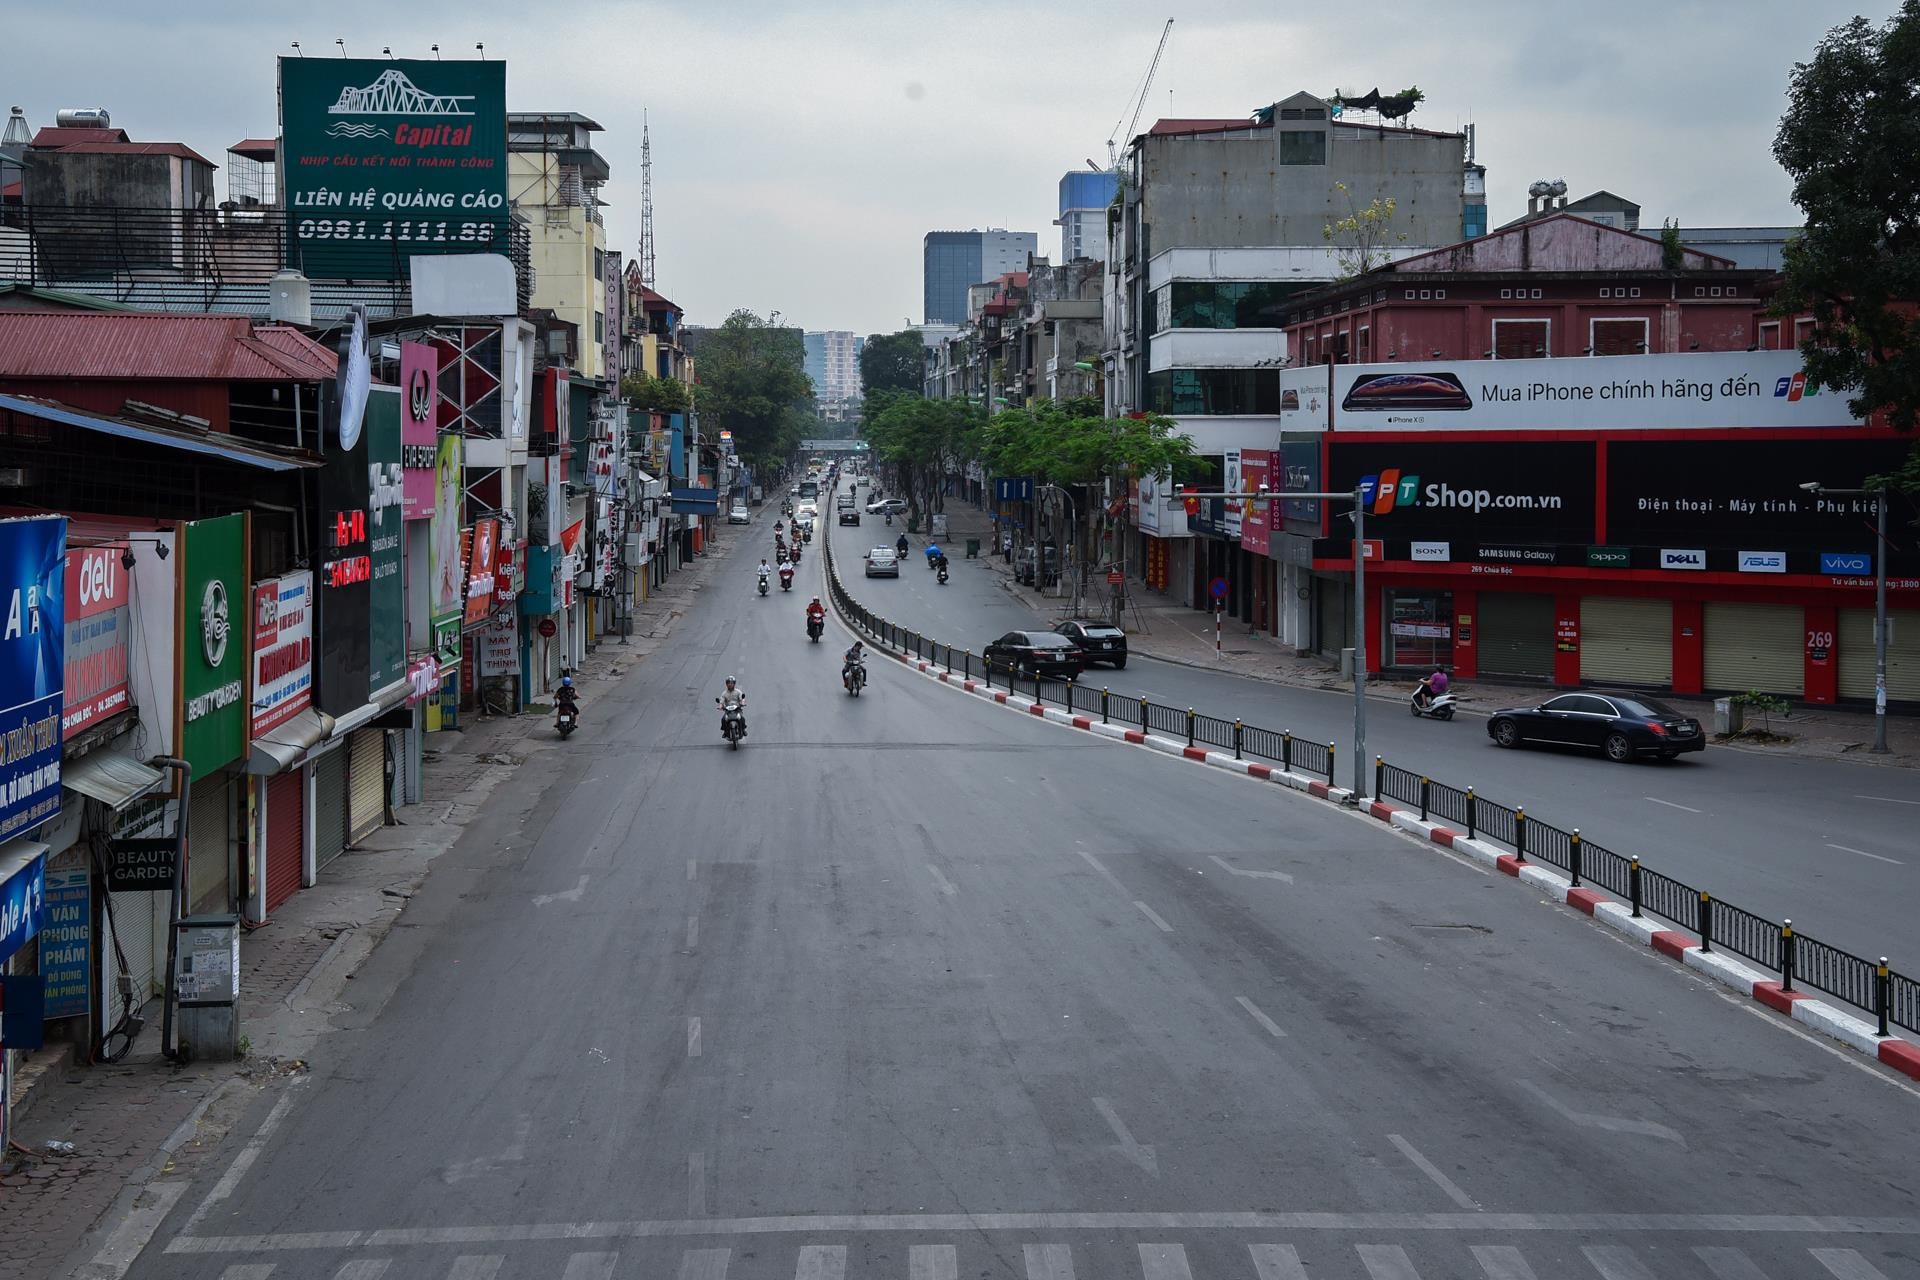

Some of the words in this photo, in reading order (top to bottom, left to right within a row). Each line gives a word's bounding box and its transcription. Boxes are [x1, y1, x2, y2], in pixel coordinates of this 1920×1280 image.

[394, 123, 472, 148] Capital
[300, 156, 330, 169] NHỊP
[334, 154, 358, 167] CẦU
[362, 154, 385, 167] KẾT
[389, 153, 411, 167] NỐI
[416, 155, 457, 168] THÀNH
[460, 155, 495, 168] CÔNG
[294, 186, 342, 206] LIÊN
[348, 187, 377, 210] HỆ
[382, 188, 454, 210] QUẢNG
[461, 188, 503, 208] CÁO
[299, 219, 495, 241] 0981.1111.88
[1481, 384, 1521, 402] Mua
[1527, 382, 1593, 401] iPhone
[1599, 380, 1654, 399] chính
[1661, 378, 1713, 402] hãng
[1719, 372, 1760, 397] đến
[1393, 416, 1413, 424] iPhone
[1425, 482, 1562, 514] Shop.com.vn
[1638, 497, 1669, 514] Điện
[1675, 498, 1713, 514] thoại
[1729, 498, 1756, 514] Máy
[1763, 498, 1797, 513] tính
[1816, 500, 1845, 517] Phụ
[500, 538, 516, 555] Phụ
[1479, 548, 1521, 559] SAMSUNG
[1523, 550, 1556, 561] Galaxy
[1590, 552, 1626, 562] oppo
[1666, 554, 1699, 565] DELL
[1742, 556, 1780, 567] ASUS
[1825, 556, 1864, 570] vivo
[80, 548, 115, 606] deli
[499, 563, 516, 579] kiện
[1471, 565, 1482, 573] 269
[498, 588, 516, 601] teen
[4, 588, 22, 641] A
[1807, 631, 1833, 648] 269
[188, 691, 215, 722] BEAUTY
[214, 680, 241, 709] GARDEN
[117, 850, 176, 865] BEAUTY
[114, 866, 176, 881] GARDEN
[22, 884, 31, 924] A
[52, 903, 80, 923] VĂN
[42, 924, 89, 944] PHÒNG
[45, 942, 85, 966] PHẨM
